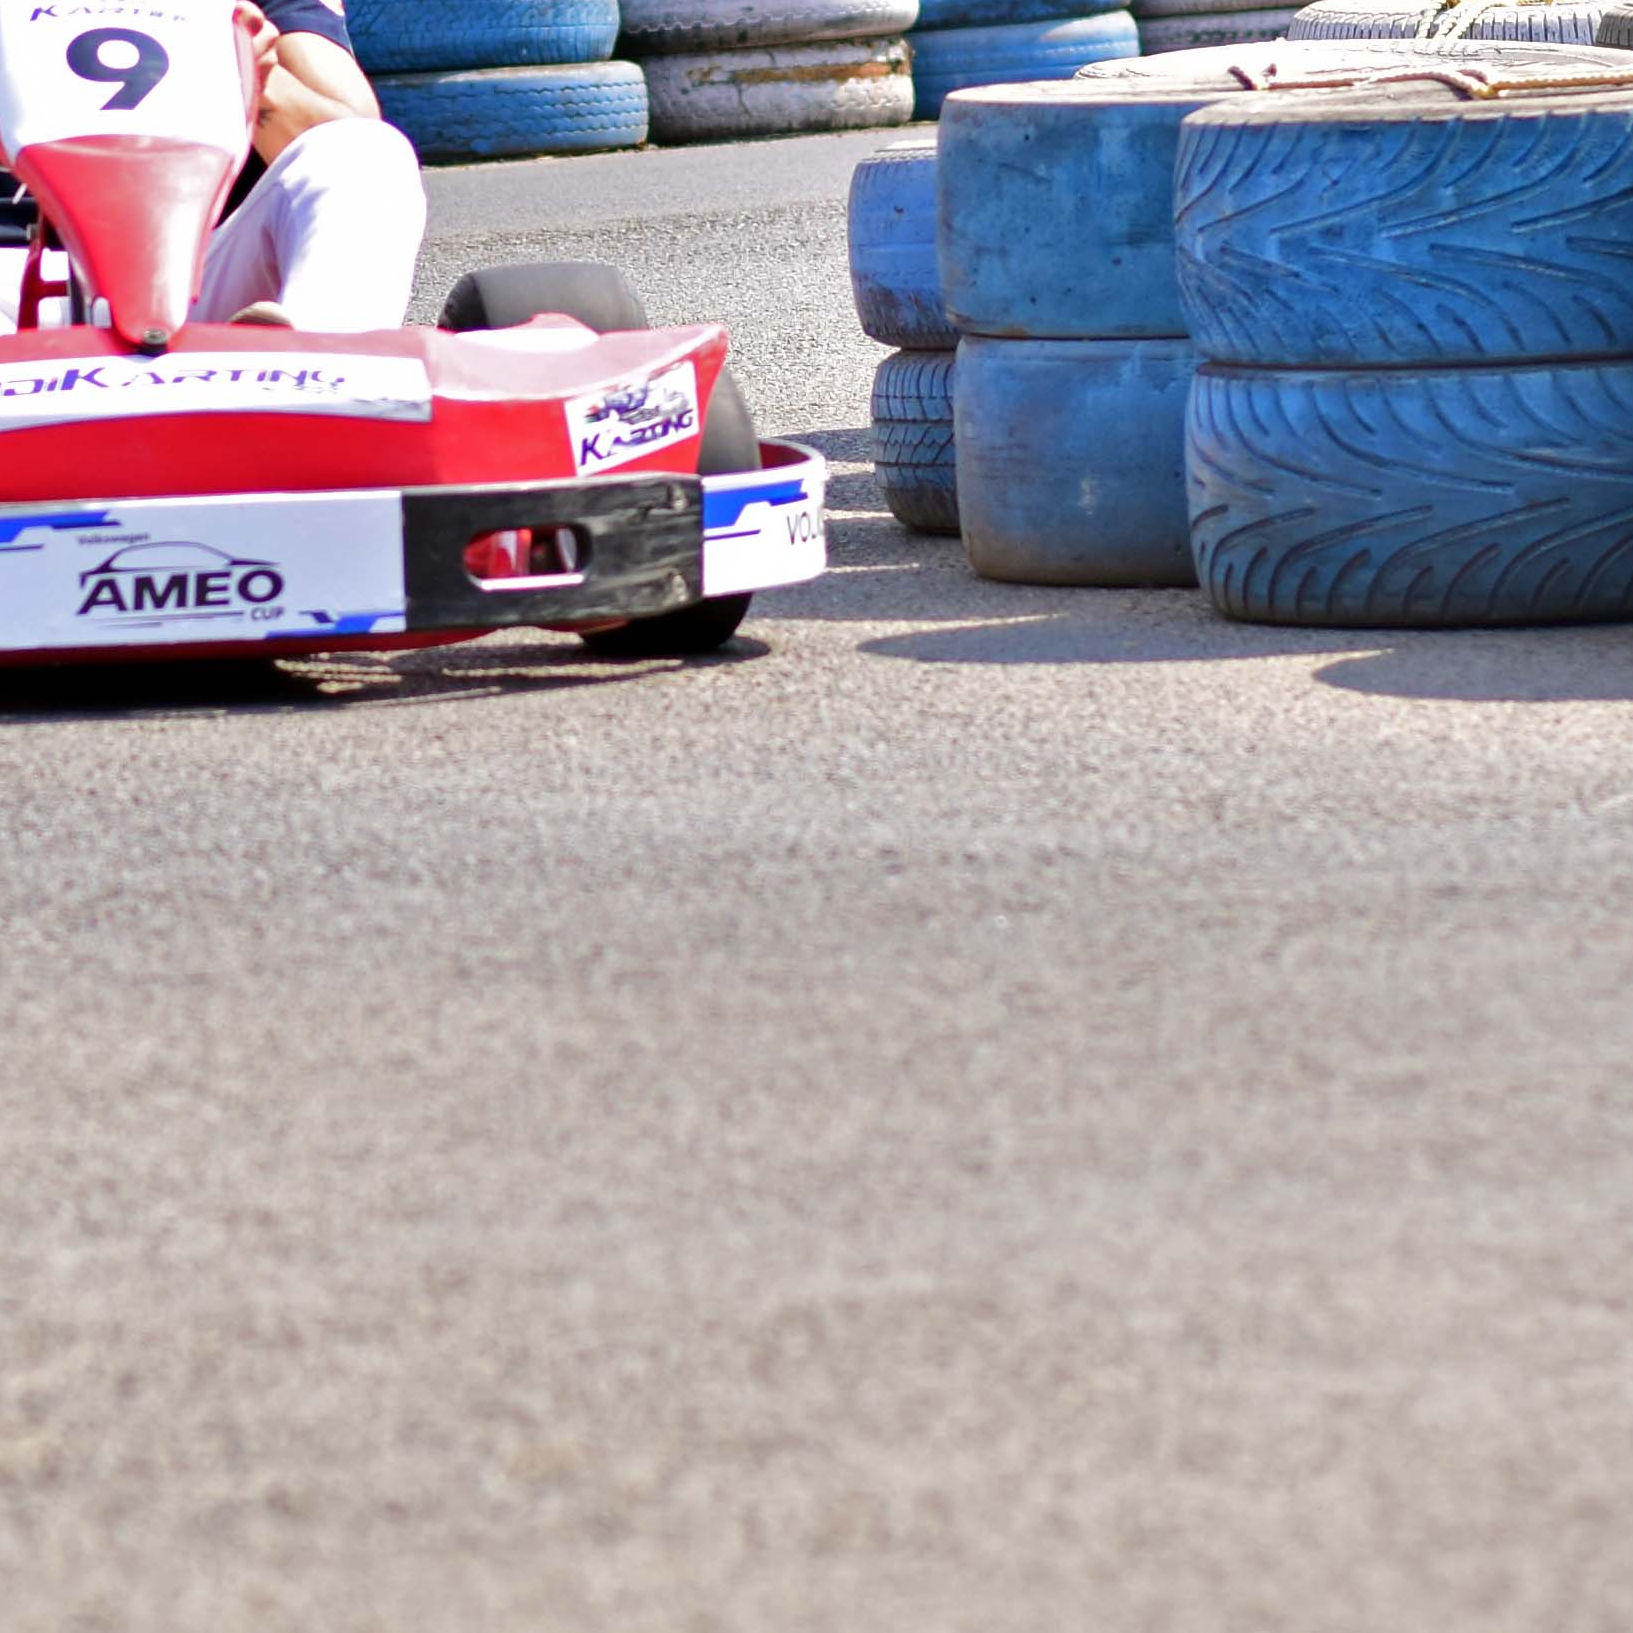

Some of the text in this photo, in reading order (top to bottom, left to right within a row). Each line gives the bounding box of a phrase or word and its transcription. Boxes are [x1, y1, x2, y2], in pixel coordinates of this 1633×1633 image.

[66, 27, 169, 110] 9
[76, 568, 284, 616] AMEO
[250, 606, 284, 622] CUP
